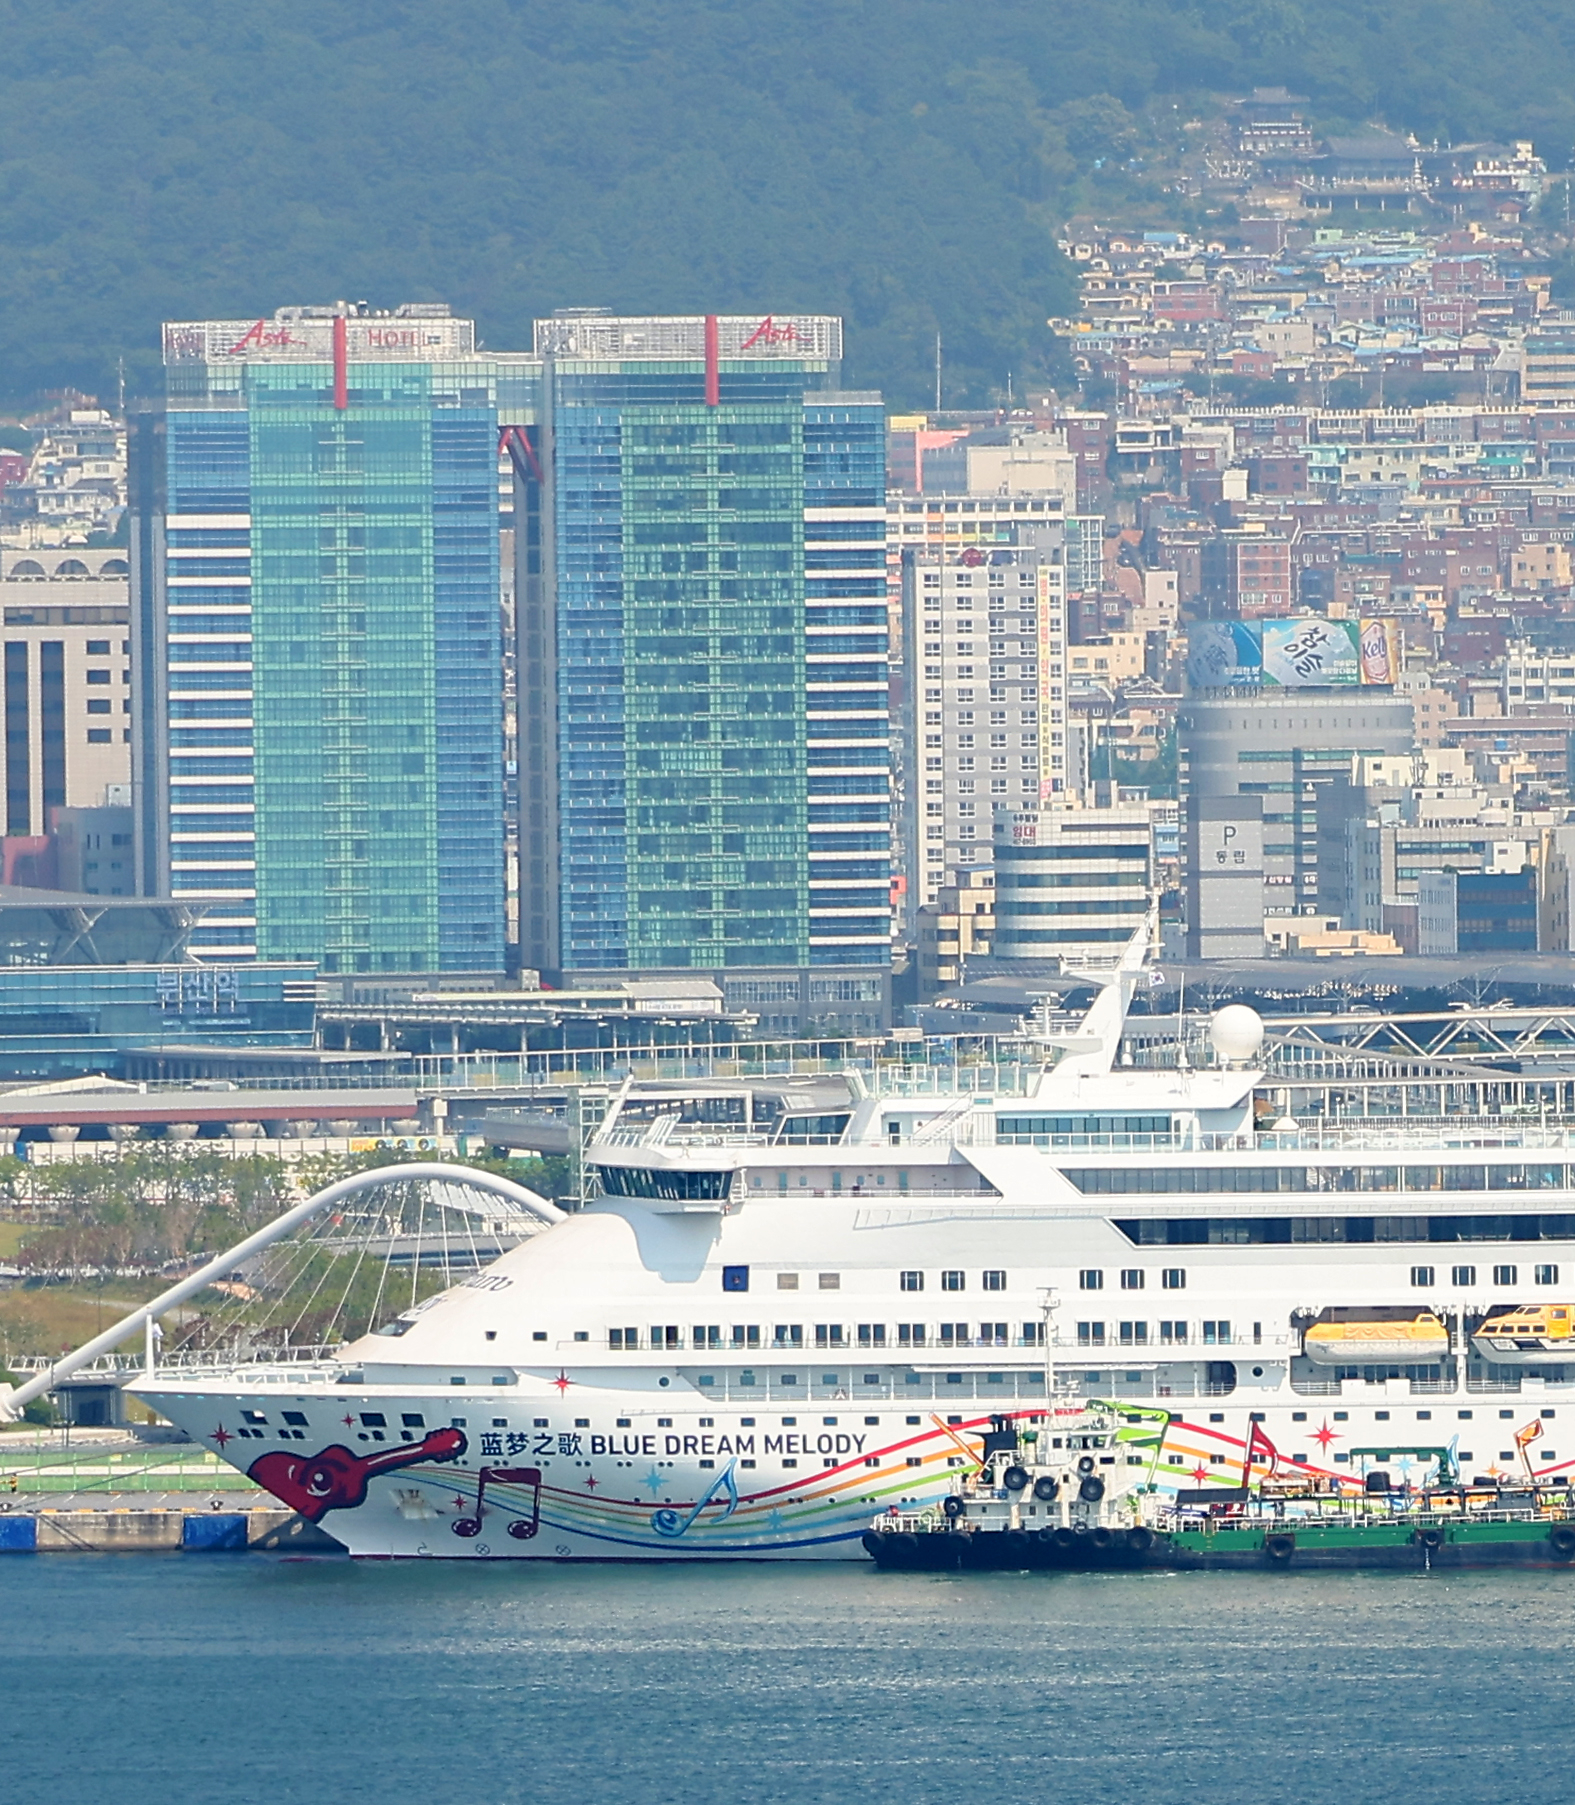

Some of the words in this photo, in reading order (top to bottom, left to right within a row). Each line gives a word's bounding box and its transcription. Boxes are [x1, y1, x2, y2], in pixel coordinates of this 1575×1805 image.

[368, 329, 429, 347] HOTEL
[1284, 626, 1331, 679] 참이슬
[1224, 826, 1236, 846] P
[156, 972, 239, 1001] 부산역
[480, 1433, 583, 1456] 蓝梦之歌
[591, 1436, 657, 1455] BLUE
[666, 1435, 755, 1454] DREAM
[764, 1434, 867, 1454] MELODY
